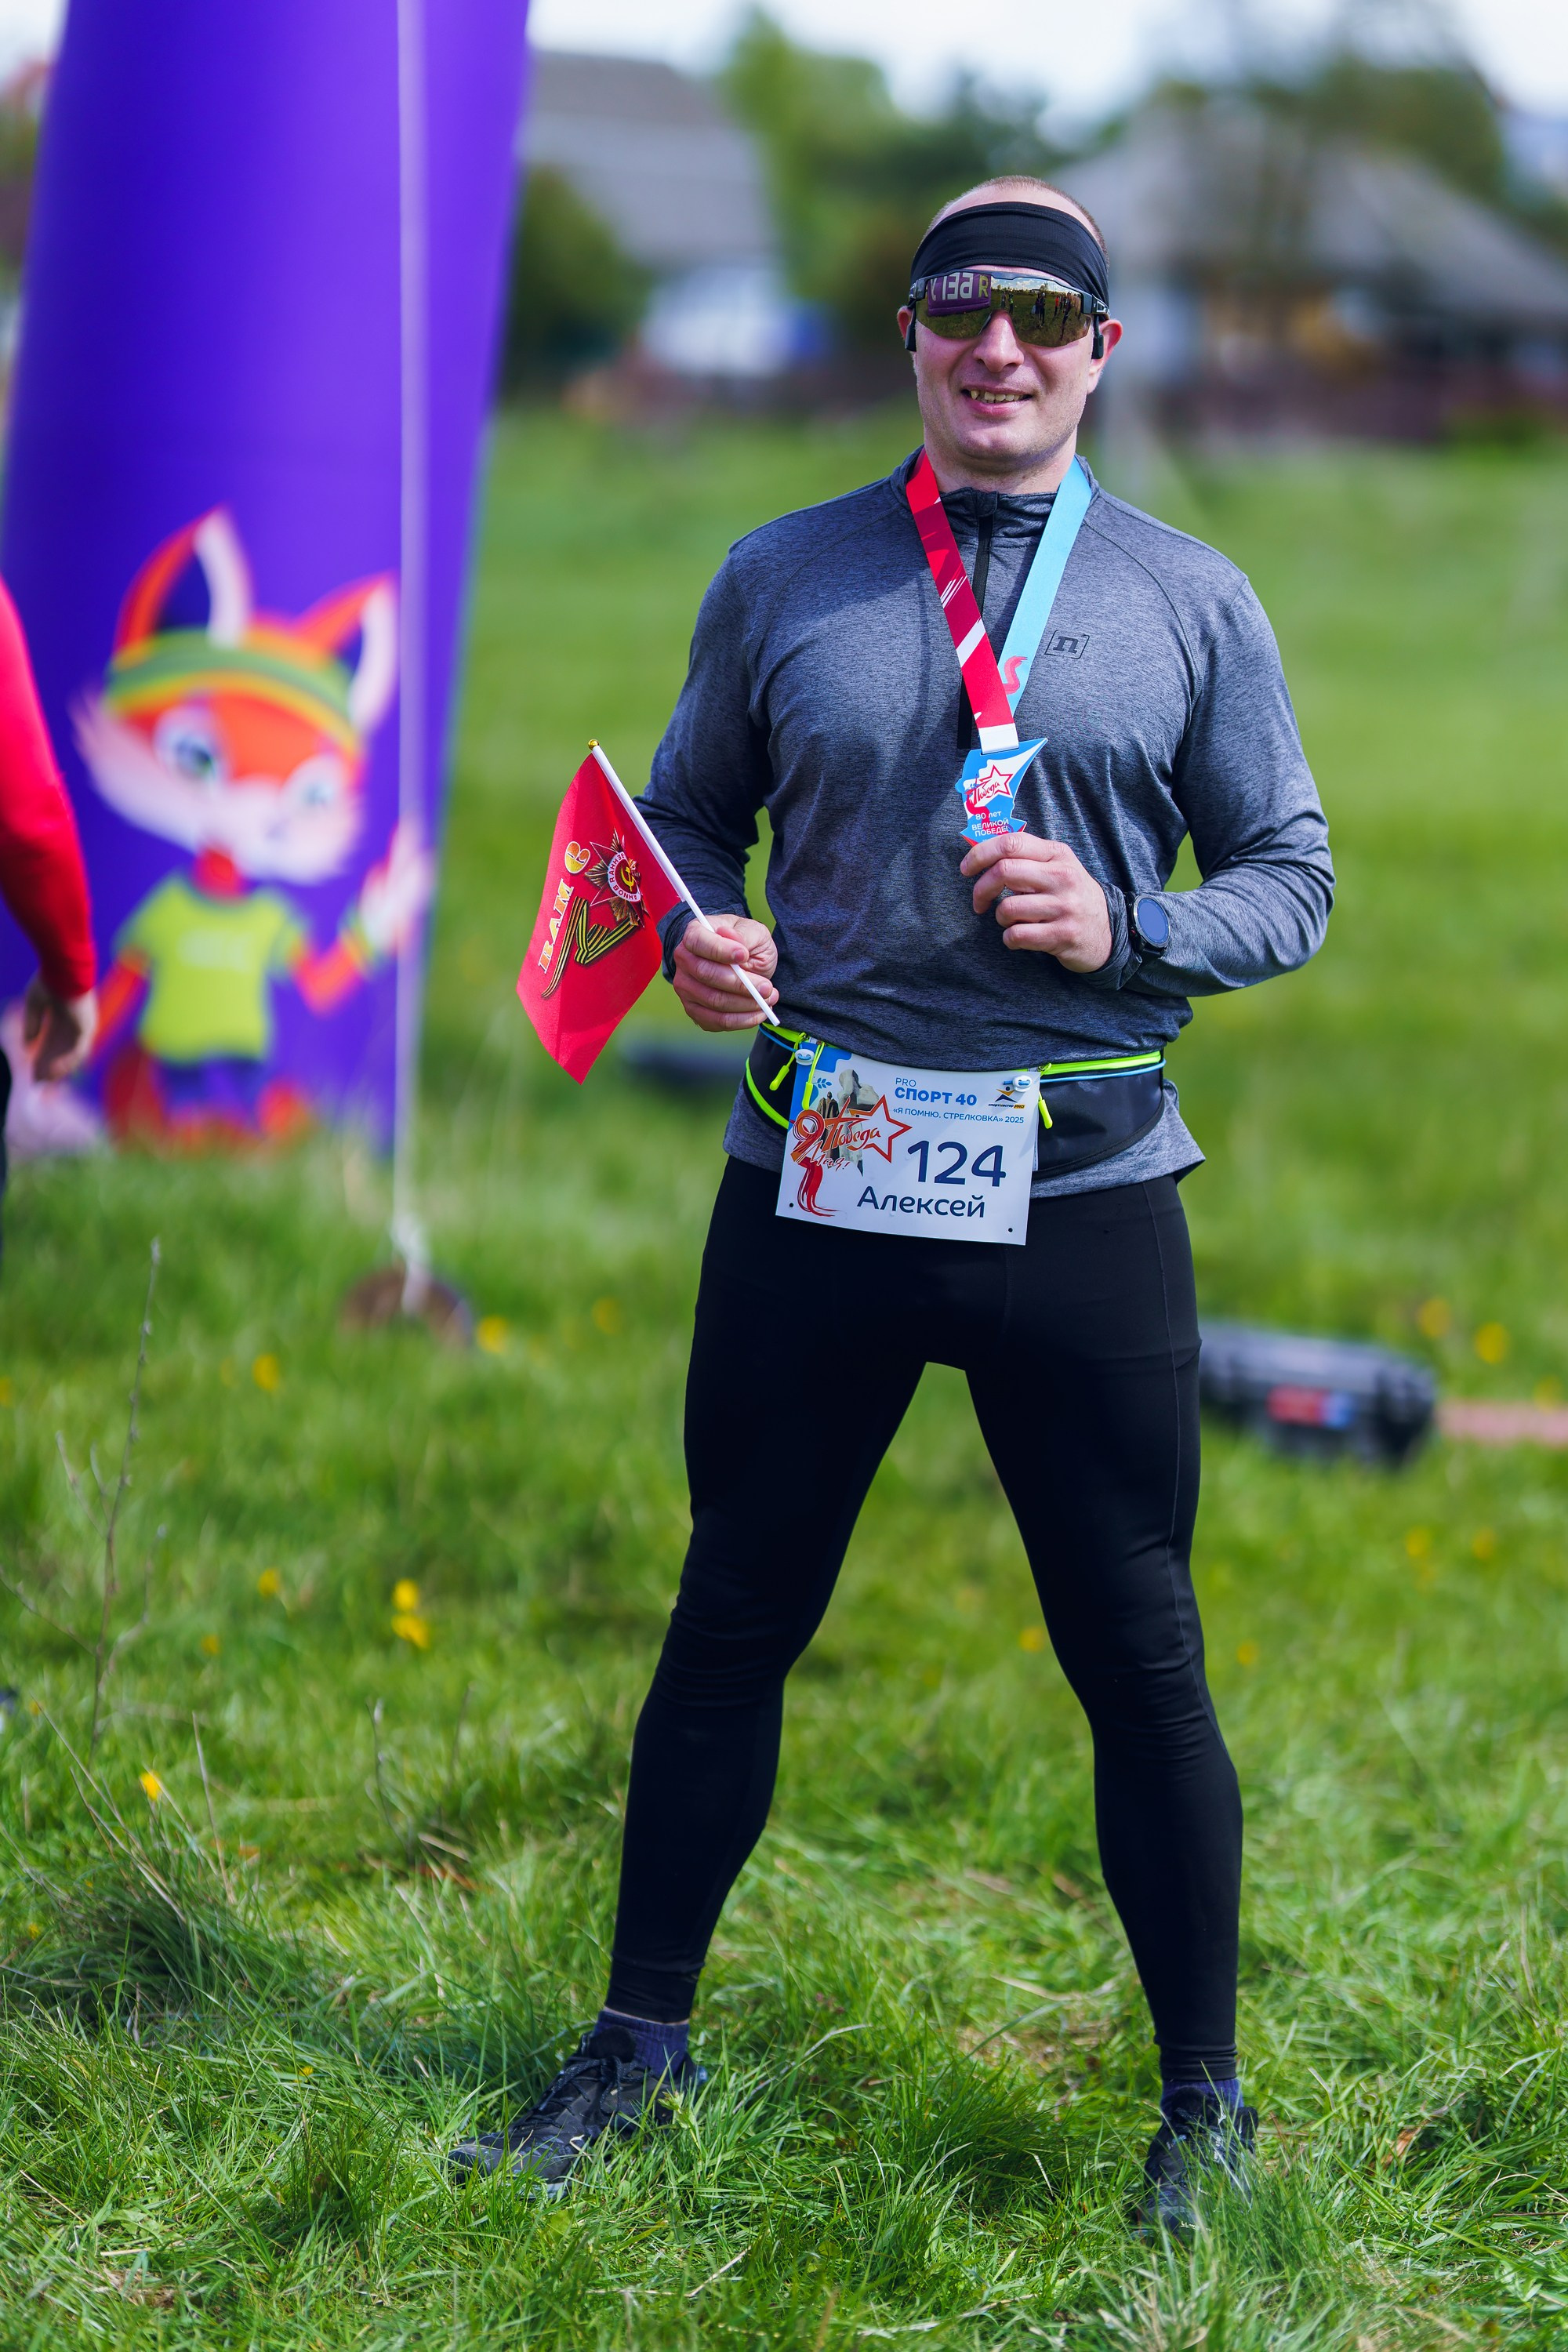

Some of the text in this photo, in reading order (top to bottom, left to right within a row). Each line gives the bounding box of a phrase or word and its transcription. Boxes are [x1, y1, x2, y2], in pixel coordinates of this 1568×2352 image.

[968, 779, 1000, 804] Победа
[971, 817, 1009, 831] ВЕЛИКОЙ
[975, 812, 986, 821] 80
[975, 826, 1009, 837] ПОБЕДЕ!
[895, 1077, 916, 1087] PRO
[895, 1087, 978, 1106] СПОРТ 40
[821, 1096, 882, 1152] Победа
[905, 1108, 941, 1119] ПОМНЮ.
[943, 1112, 1004, 1123] СТРЕЛКОВКА»
[907, 1140, 1007, 1188] 124
[857, 1185, 985, 1218] Алексей
